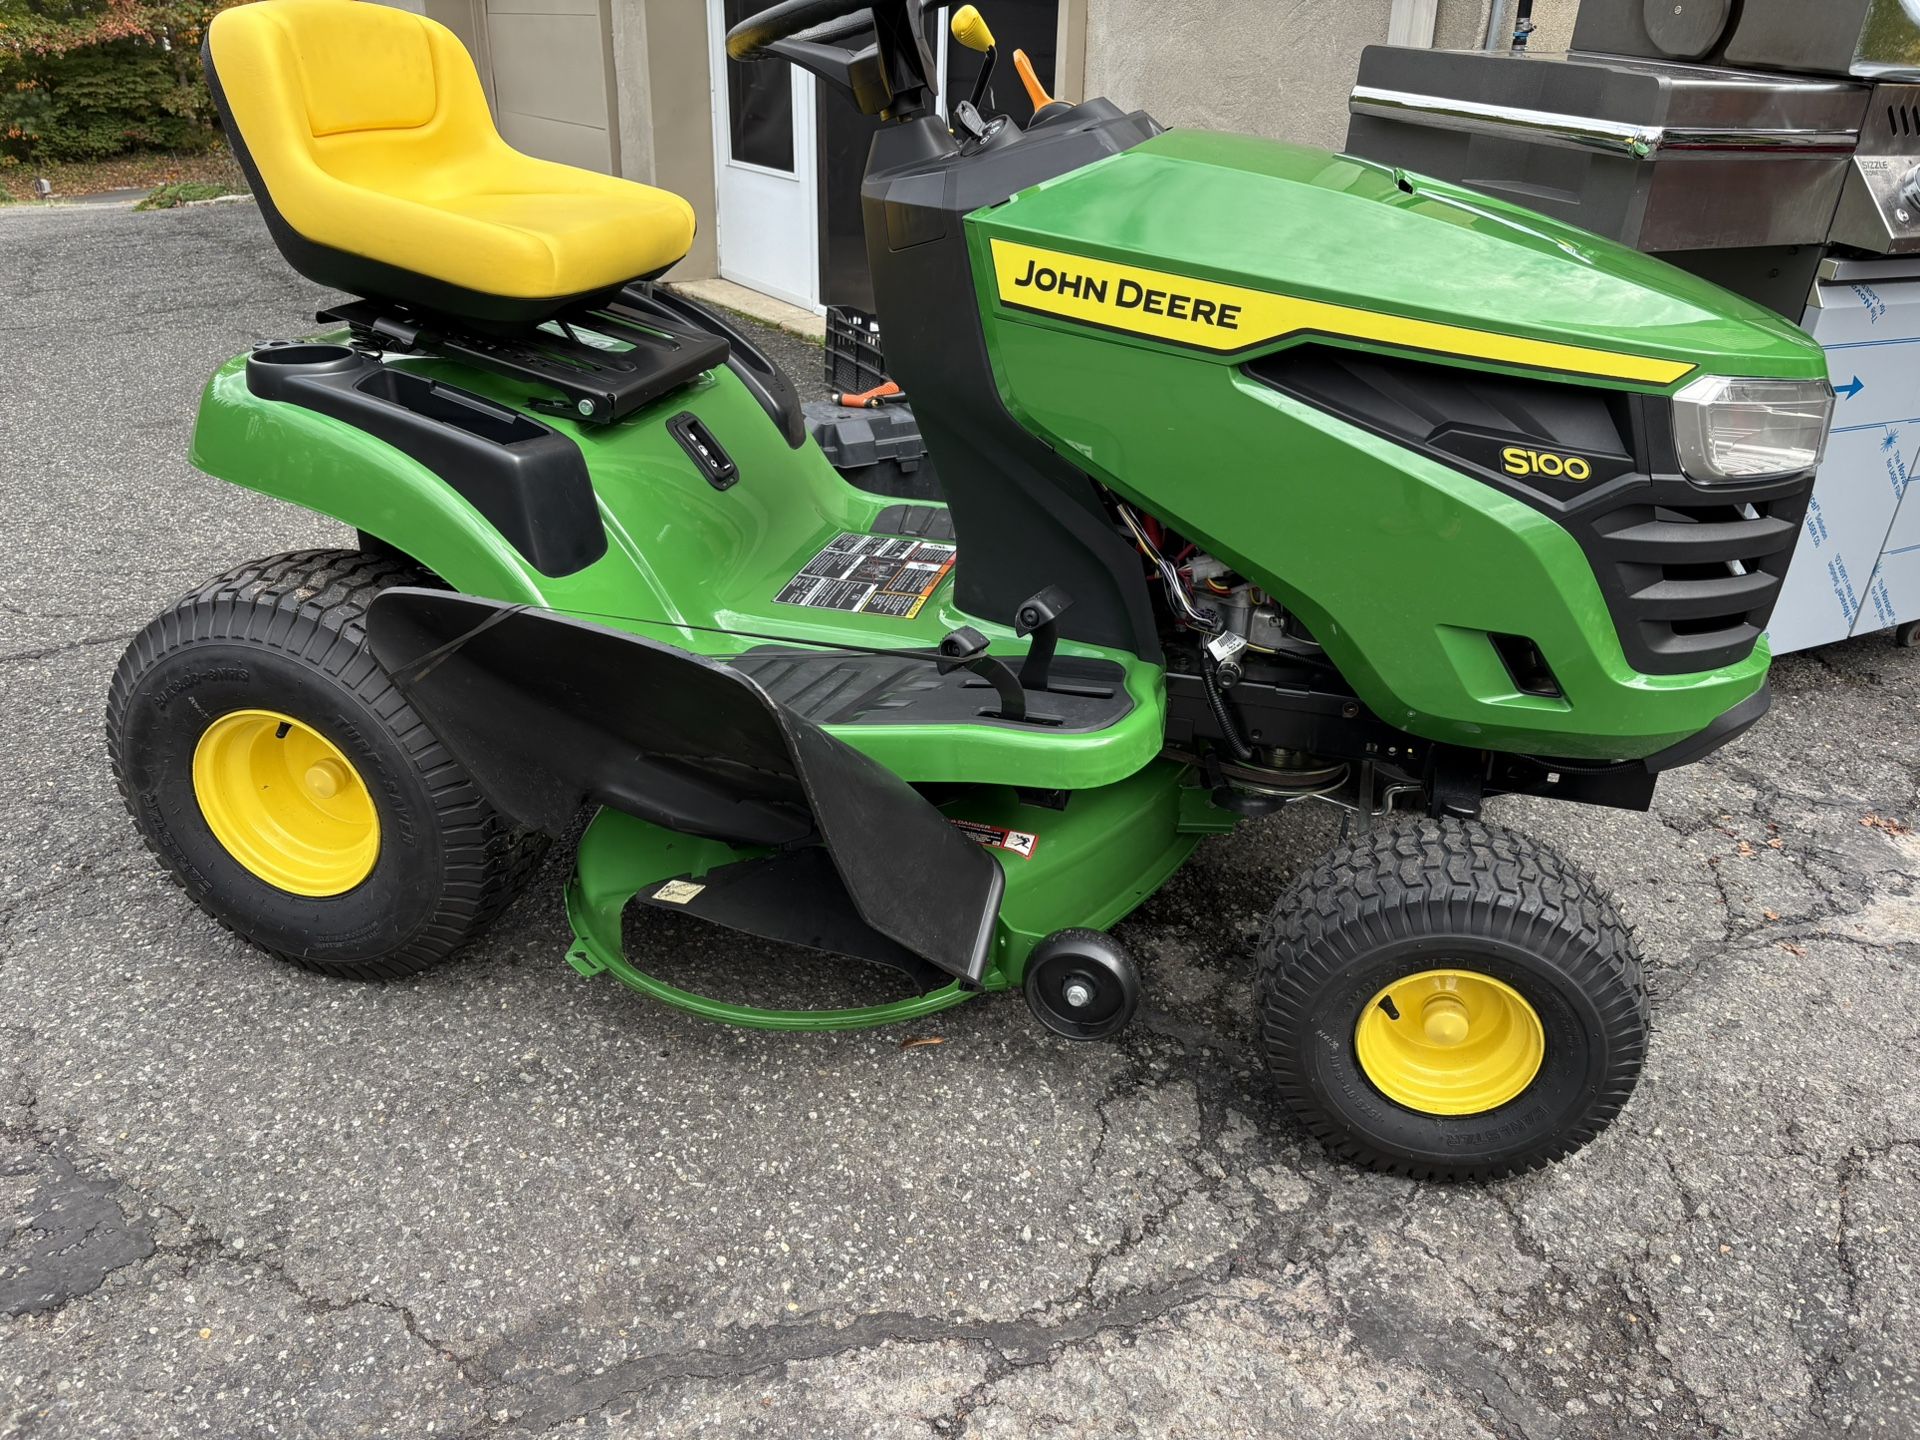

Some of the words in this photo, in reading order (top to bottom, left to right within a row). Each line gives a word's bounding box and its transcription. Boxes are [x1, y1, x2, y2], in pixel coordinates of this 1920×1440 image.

[1861, 160, 1888, 170] SIZZLE
[1014, 259, 1108, 304] JOHN
[1114, 278, 1242, 330] DEERE
[1502, 447, 1590, 480] S100
